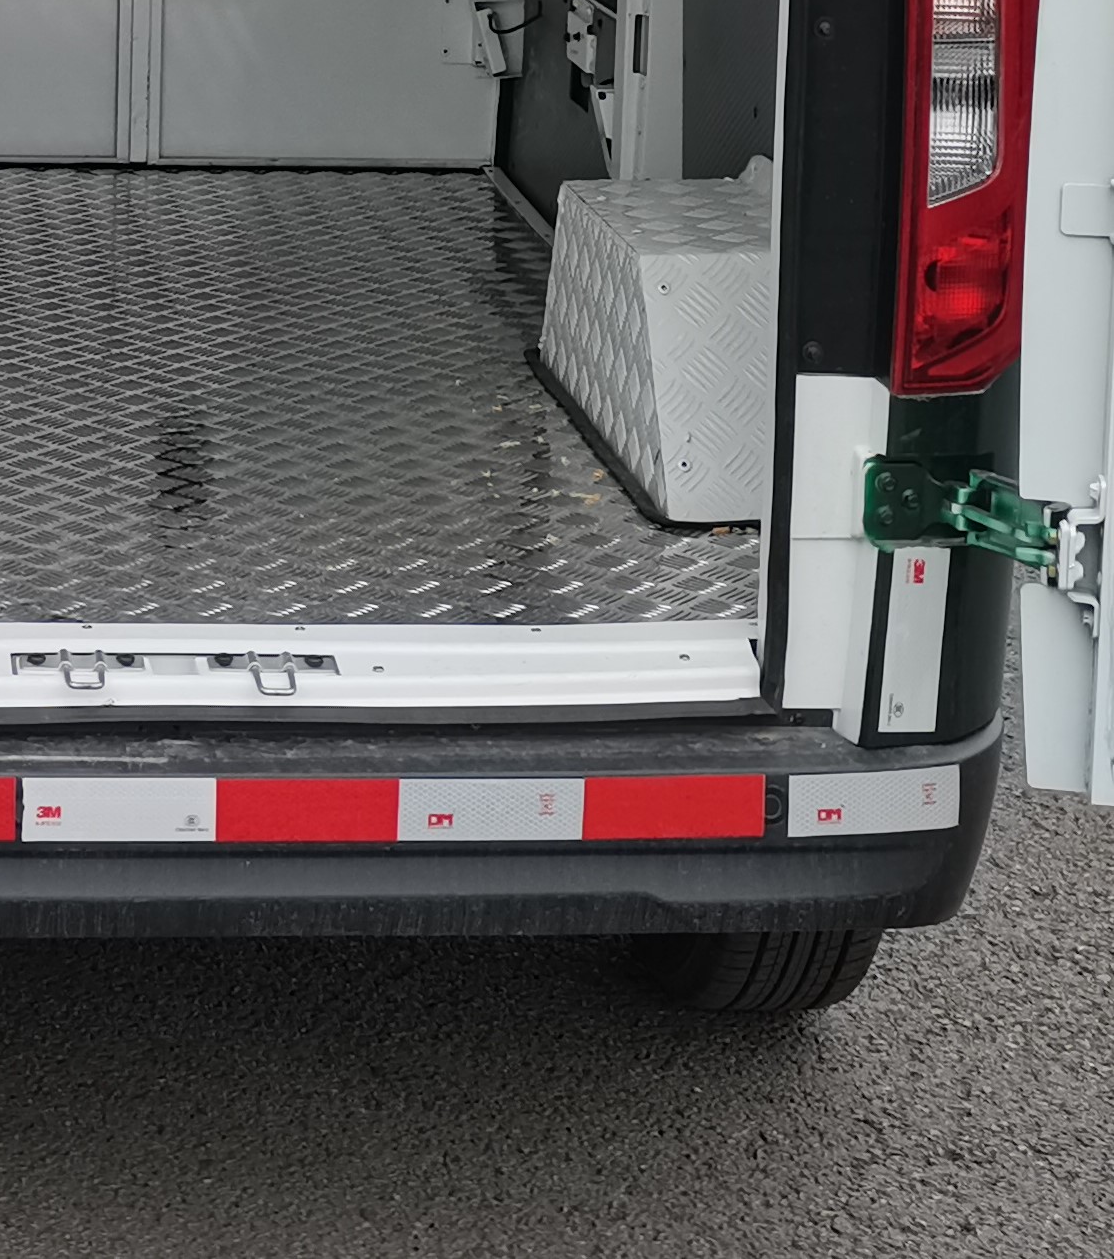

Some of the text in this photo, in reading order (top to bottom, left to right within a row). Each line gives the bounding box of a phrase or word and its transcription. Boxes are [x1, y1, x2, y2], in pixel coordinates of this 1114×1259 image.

[913, 558, 926, 584] 3M
[36, 806, 62, 819] 3M
[817, 808, 843, 822] DM
[427, 814, 454, 827] DM
